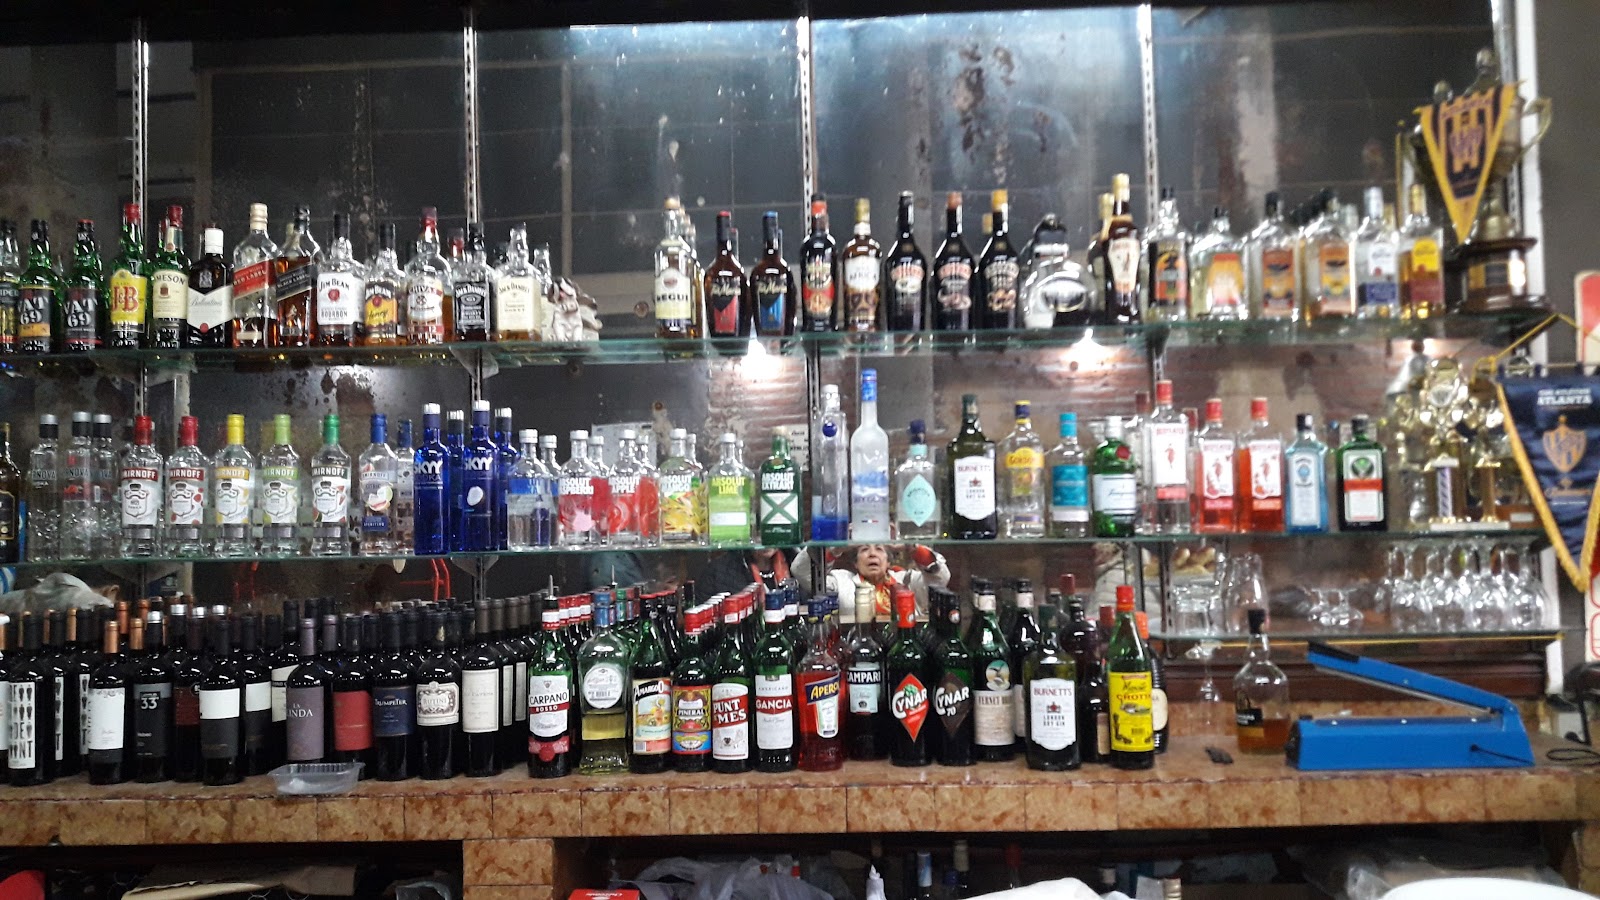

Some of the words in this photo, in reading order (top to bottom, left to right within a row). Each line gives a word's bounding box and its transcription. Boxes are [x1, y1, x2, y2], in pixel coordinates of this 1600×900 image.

[319, 280, 331, 292] JIM
[331, 278, 350, 290] BEAM
[375, 285, 392, 299] BEAM
[17, 296, 49, 312] VAT
[63, 297, 98, 314] VAT
[20, 309, 42, 325] 69
[67, 311, 91, 327] 69
[1537, 395, 1593, 405] ATLANTA
[762, 472, 795, 482] ABSOLUT
[719, 485, 738, 495] LIME
[847, 670, 880, 684] CAMPARI
[811, 681, 840, 700] APERO
[1033, 687, 1073, 697] BURNETT'S
[374, 698, 408, 706] TRUMPETER
[530, 691, 568, 705] CARPANO
[756, 698, 792, 710] GANCIA
[892, 687, 928, 719] CYNAR
[934, 686, 969, 716] CYNAR
[713, 698, 741, 714] PUNT
[946, 707, 957, 717] 70
